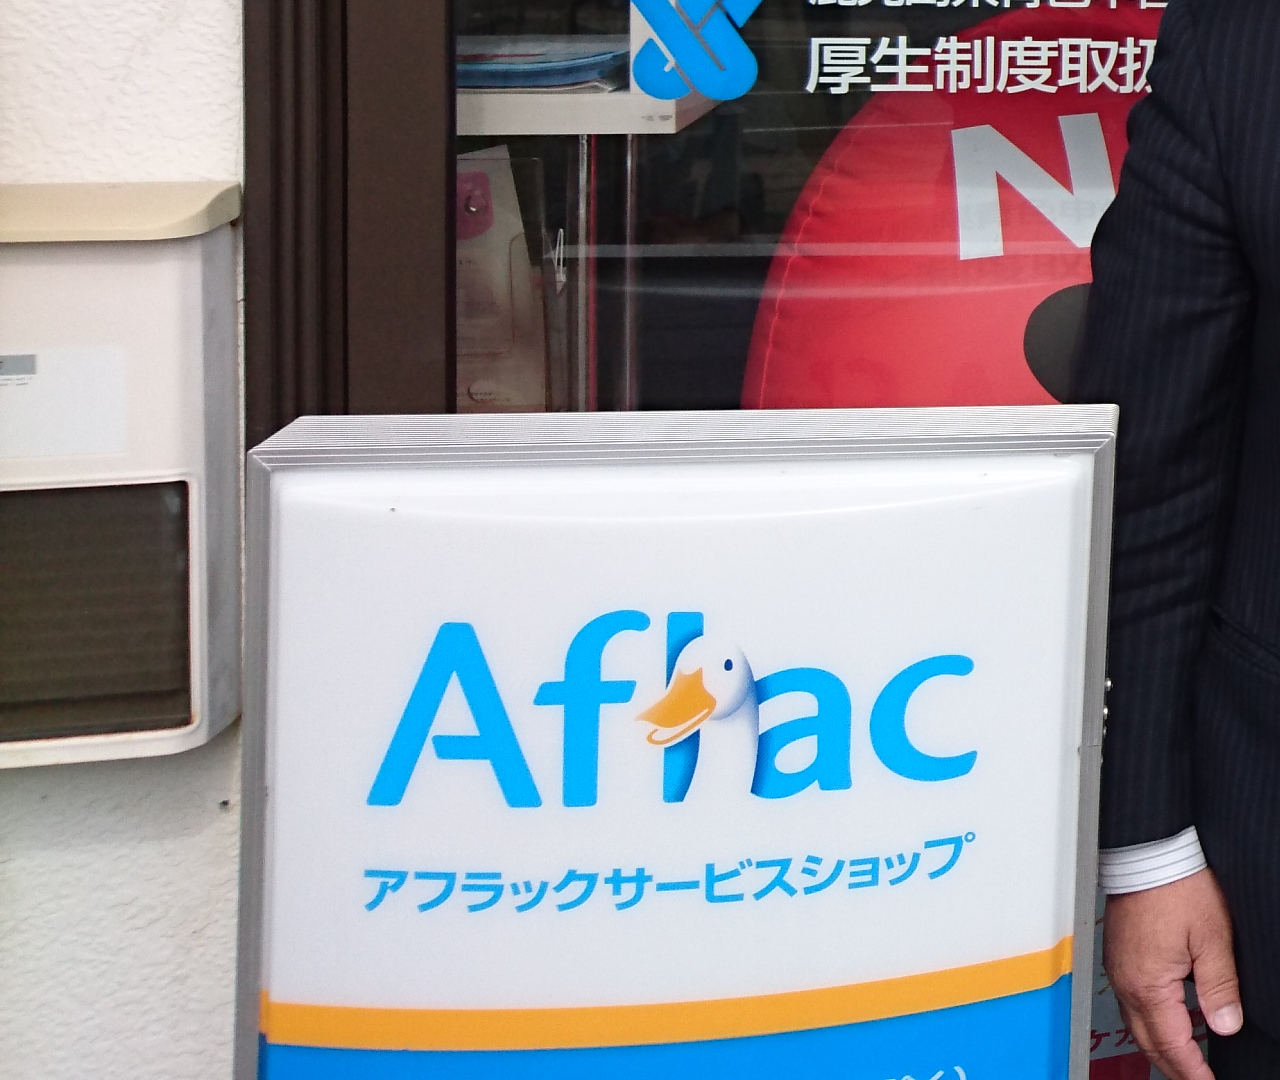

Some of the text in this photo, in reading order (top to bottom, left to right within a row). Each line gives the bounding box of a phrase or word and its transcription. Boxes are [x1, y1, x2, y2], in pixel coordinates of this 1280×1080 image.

[366, 609, 978, 809] Aflac
[363, 831, 976, 913] アフラックサービスショップ
